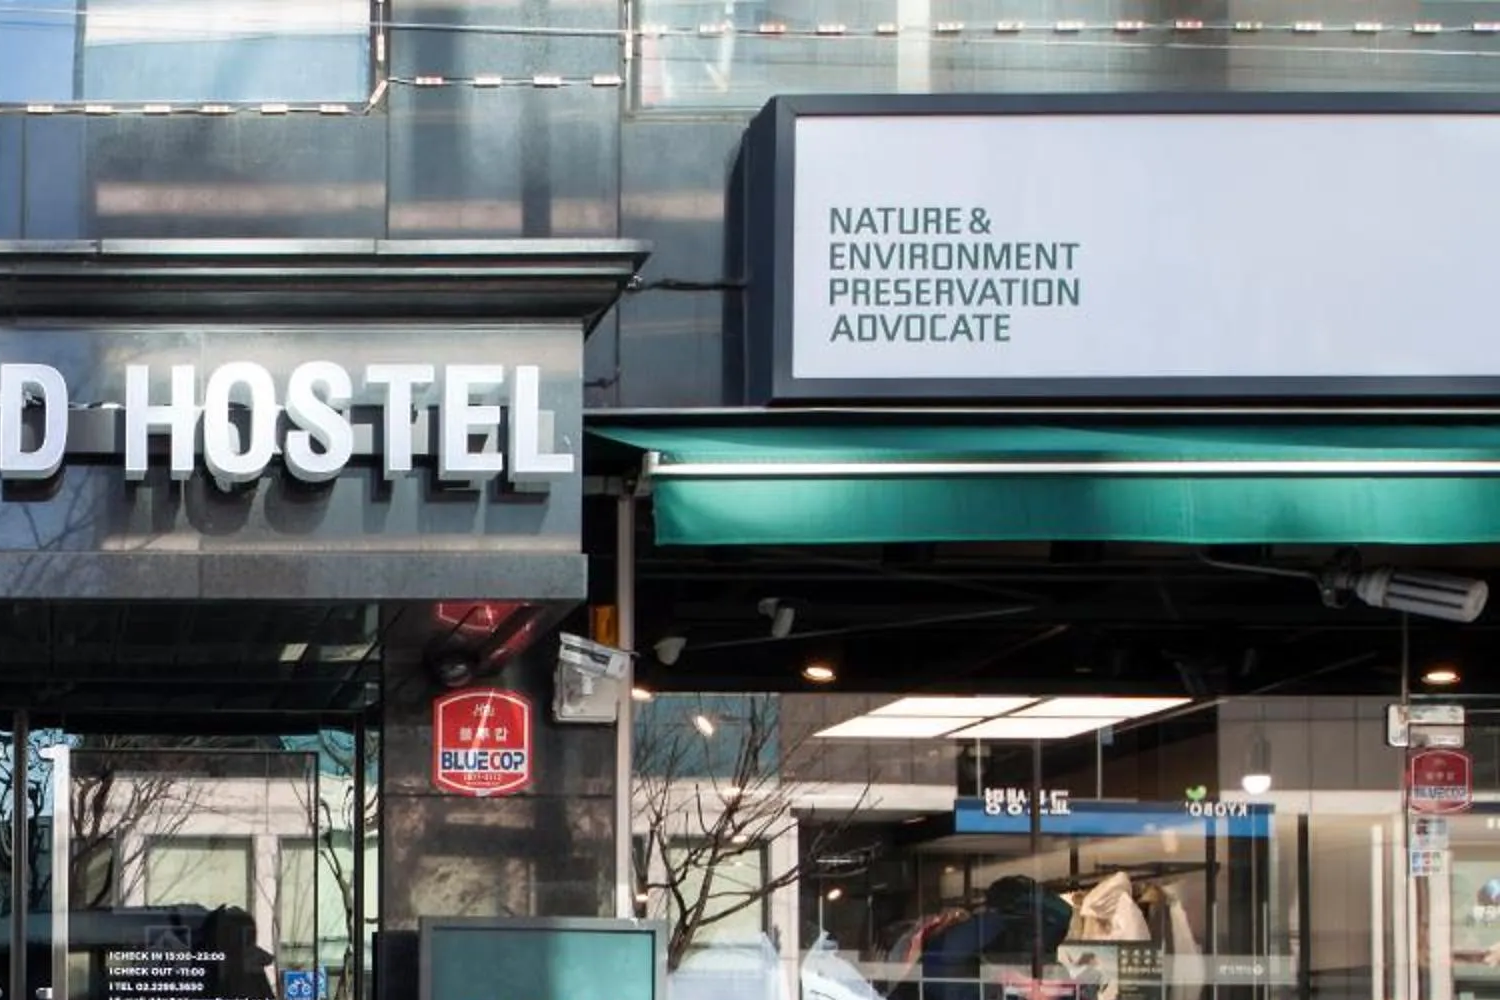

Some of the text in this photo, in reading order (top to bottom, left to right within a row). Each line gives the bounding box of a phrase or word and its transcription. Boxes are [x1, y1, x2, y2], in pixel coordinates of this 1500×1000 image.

[829, 207, 991, 234] NATURE &
[829, 243, 1080, 270] ENVIRONMENT
[829, 278, 1079, 306] PRESERVATION
[829, 314, 1011, 342] ADVOCATE
[124, 360, 576, 486] HOSTEL
[442, 751, 525, 770] BLUECOP
